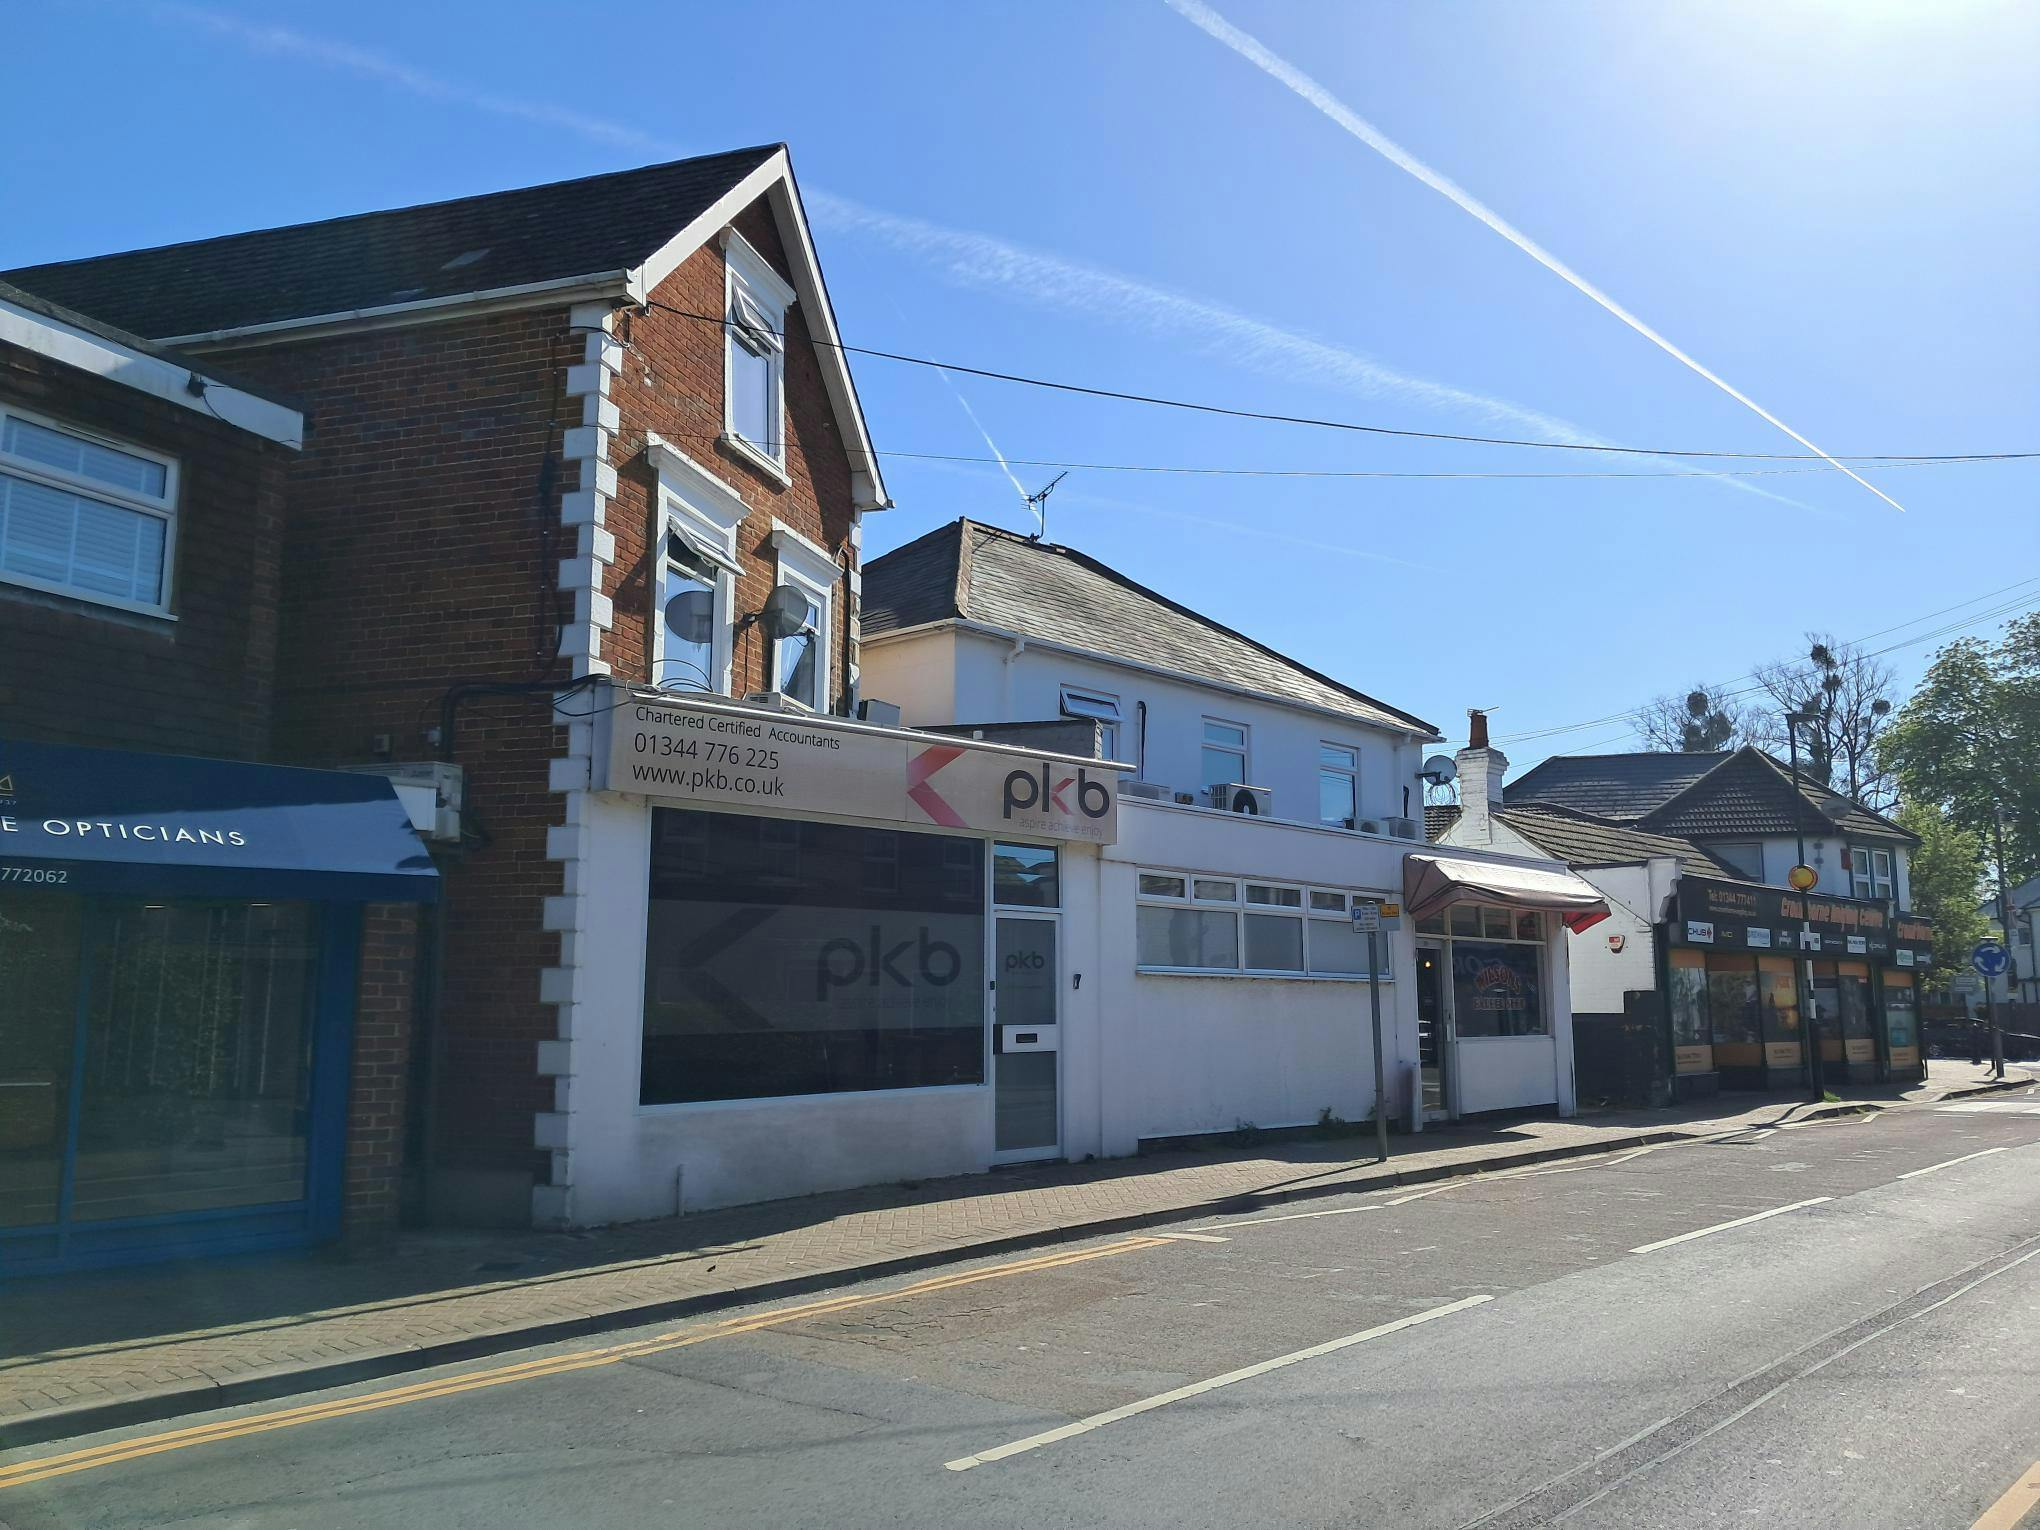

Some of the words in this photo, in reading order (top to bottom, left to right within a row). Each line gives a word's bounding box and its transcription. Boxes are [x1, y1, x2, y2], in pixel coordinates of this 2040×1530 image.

[635, 706, 704, 729] Chartered
[708, 717, 761, 738] Certified
[768, 727, 840, 750] Accountants
[634, 732, 698, 759] 01344
[704, 741, 740, 765] 776
[745, 748, 779, 770] 225
[632, 764, 784, 797] www.pkb.co.uk
[1003, 762, 1110, 819] pkb
[42, 819, 246, 846] OPTICIANS
[1, 867, 68, 884] 772062
[816, 924, 962, 1002] pkb
[1005, 950, 1045, 973] pkb
